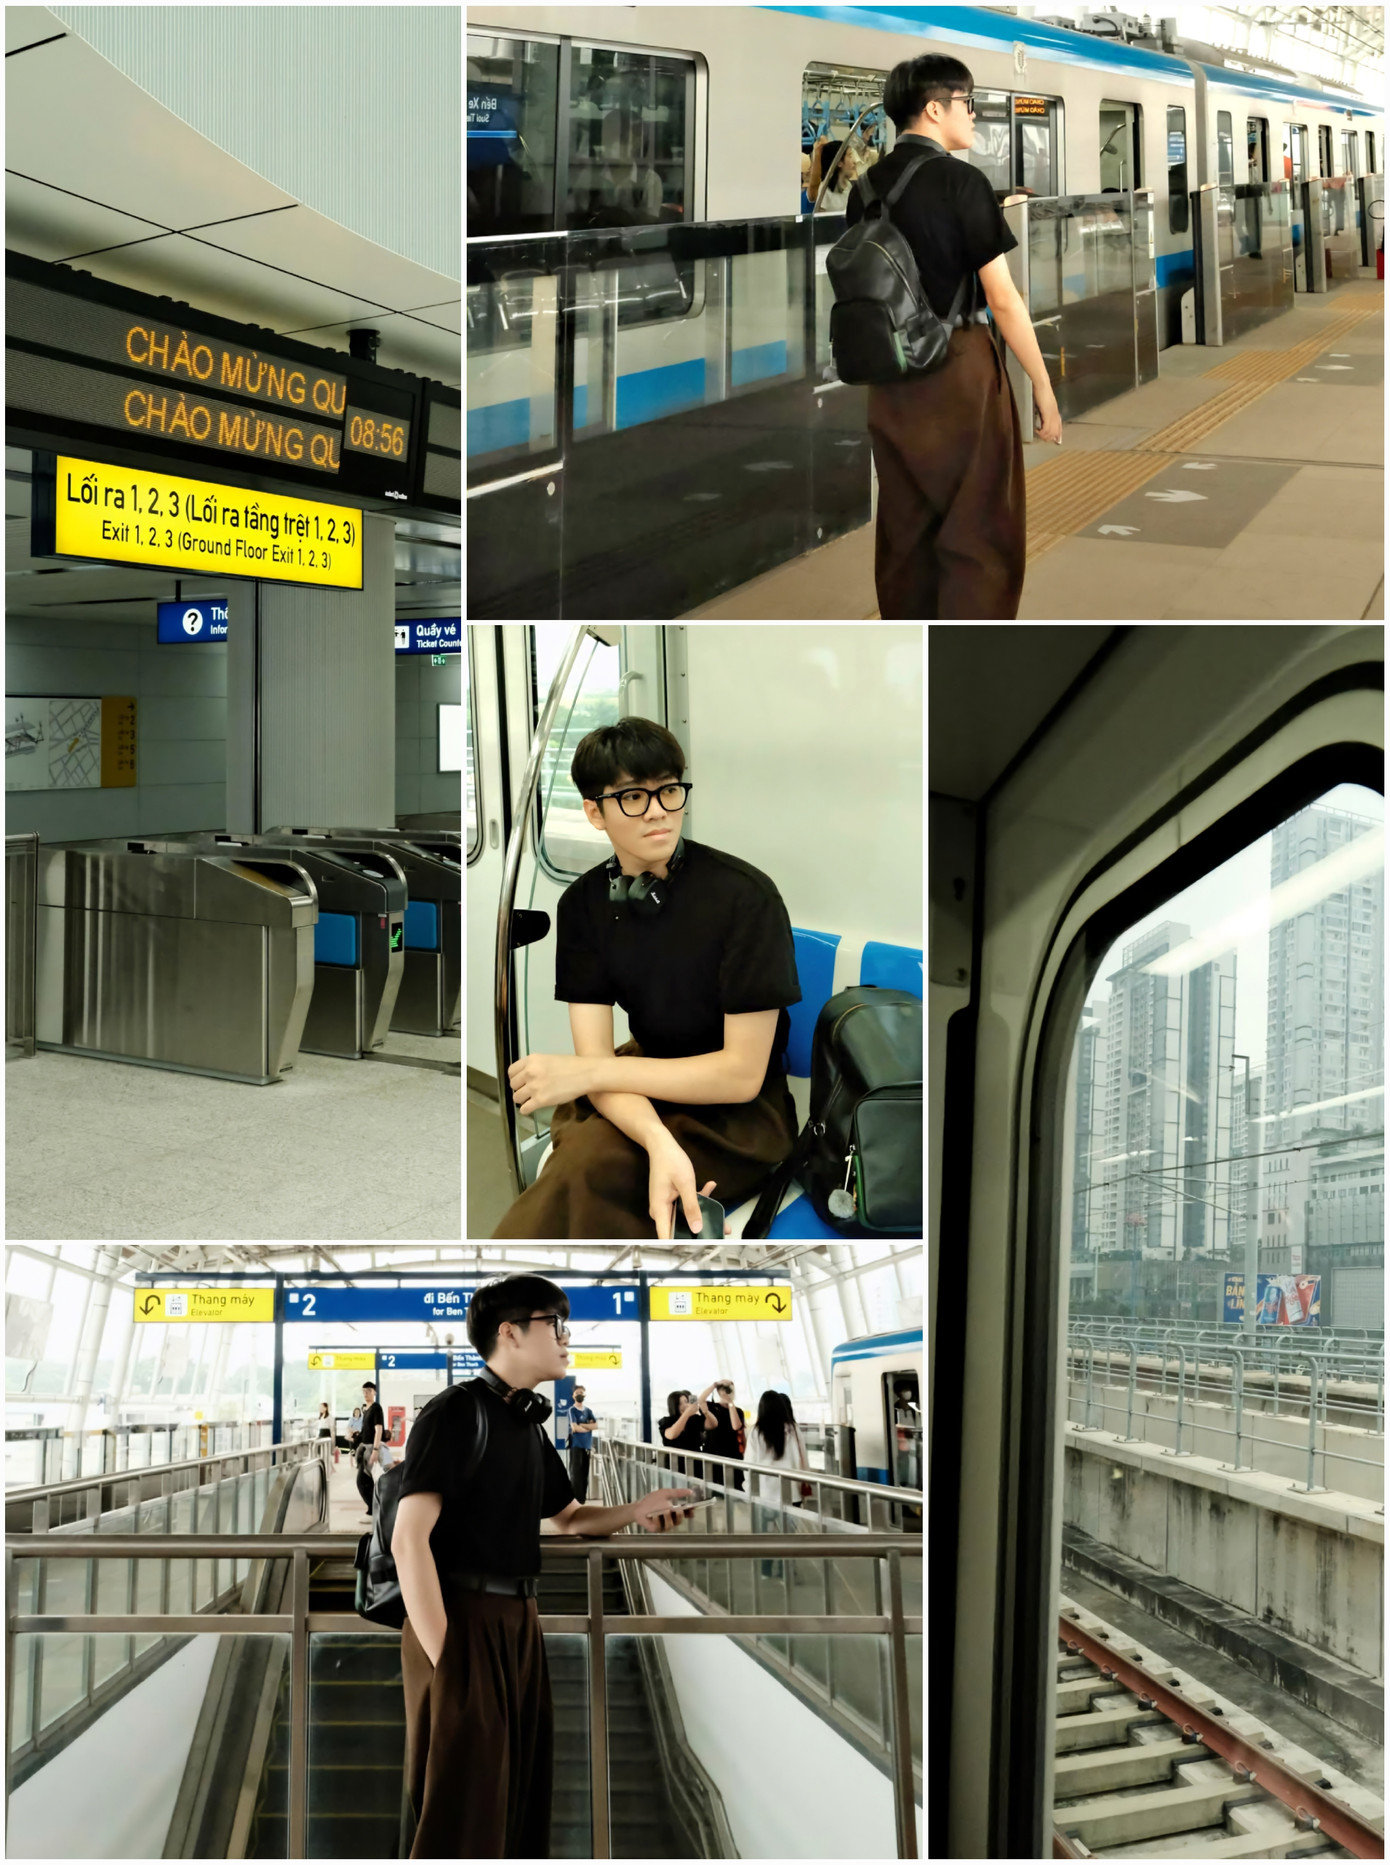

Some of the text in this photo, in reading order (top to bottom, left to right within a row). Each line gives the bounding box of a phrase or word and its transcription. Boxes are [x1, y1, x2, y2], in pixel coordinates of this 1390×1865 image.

[126, 326, 347, 414] CHÀO MỪNG QU
[124, 390, 212, 440] CHÀO
[218, 411, 304, 460] MỪNG
[350, 415, 405, 456] 08:56
[67, 472, 356, 548] Lối ra 1, 2, 3 (Lối ra tầng trệt 1, 2, 3)
[102, 519, 332, 571] Exit 1, 2, 3 (Ground Floor Exit 1, 2, 3)
[443, 622, 457, 636] vé
[416, 639, 438, 649] Ticket
[192, 1293, 255, 1308] Thang máy
[423, 1292, 435, 1304] đi
[437, 1290, 460, 1304] Bến
[612, 1291, 622, 1315] 1
[695, 1292, 732, 1306] Thang
[301, 1293, 317, 1317] 2
[432, 1306, 445, 1316] for
[446, 1306, 463, 1316] Ben
[695, 1306, 729, 1316] Elevator
[191, 1308, 223, 1318] Elevator
[387, 1355, 396, 1368] 2
